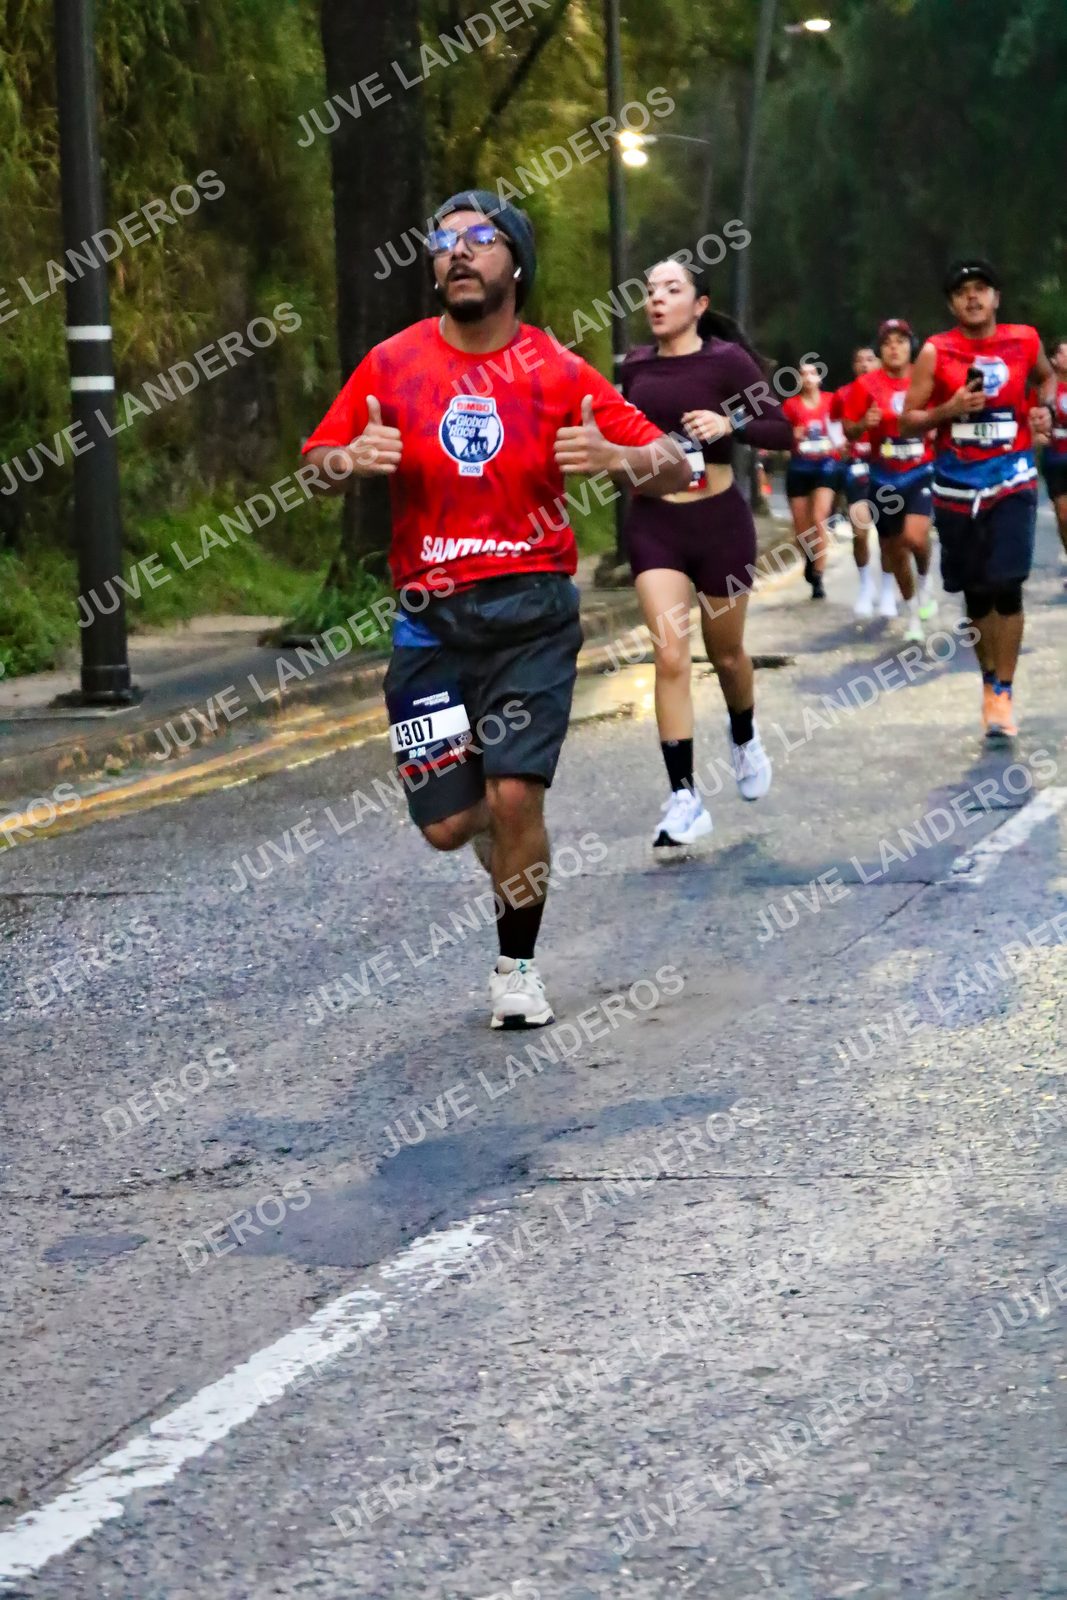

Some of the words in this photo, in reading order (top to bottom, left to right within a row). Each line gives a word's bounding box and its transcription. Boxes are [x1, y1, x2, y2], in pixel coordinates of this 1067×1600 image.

[457, 402, 490, 412] BIMBO
[456, 415, 489, 429] Global
[449, 425, 476, 438] Race
[395, 716, 434, 748] 4307
